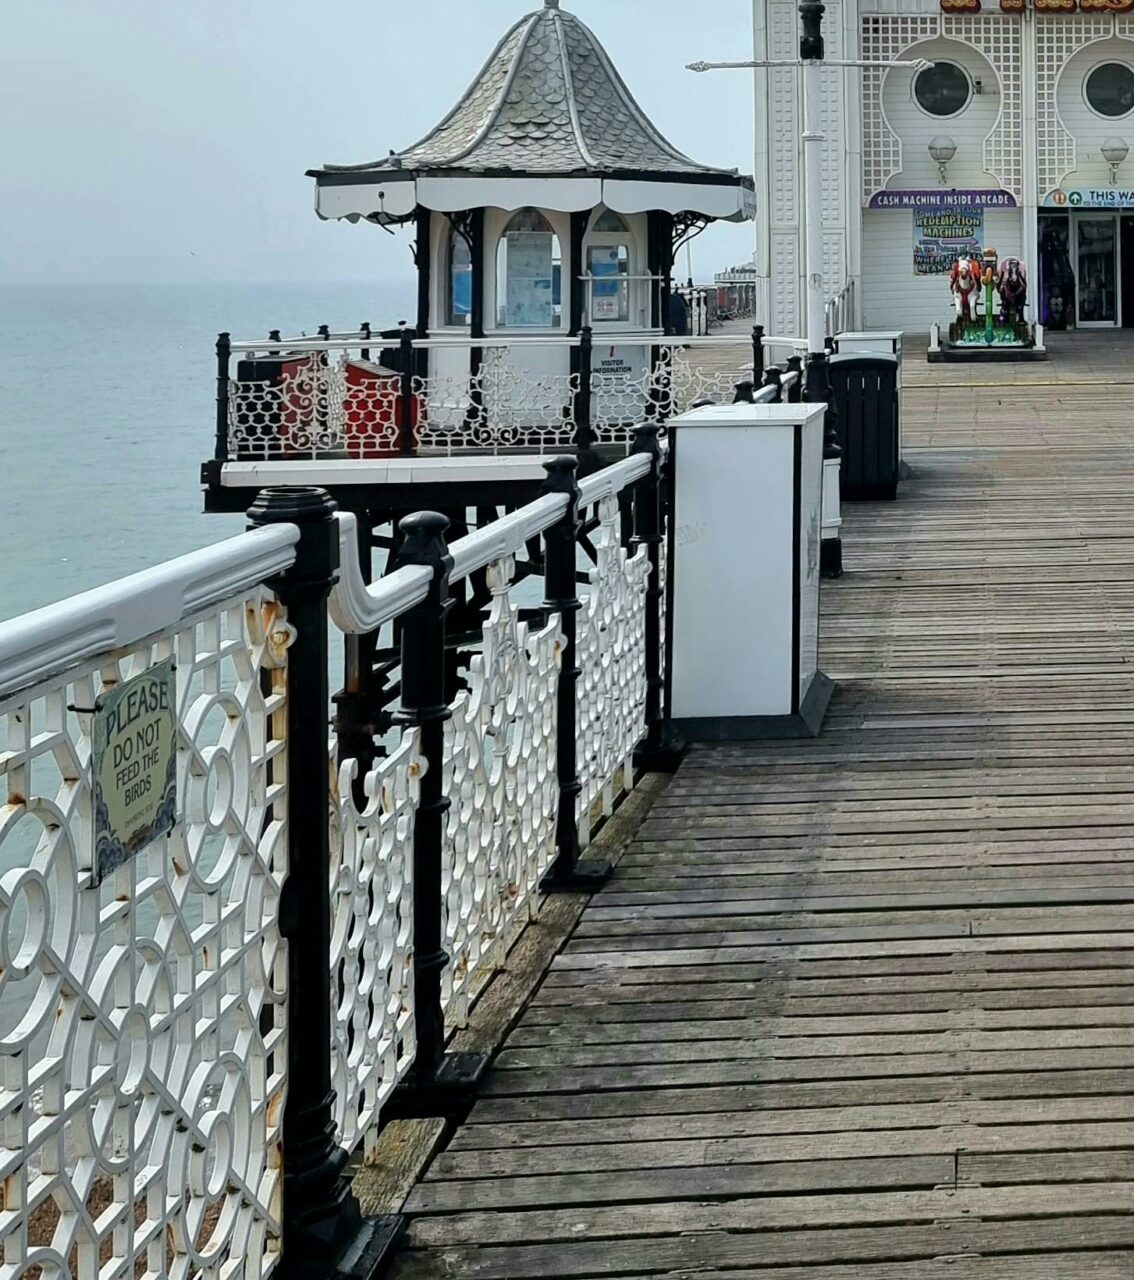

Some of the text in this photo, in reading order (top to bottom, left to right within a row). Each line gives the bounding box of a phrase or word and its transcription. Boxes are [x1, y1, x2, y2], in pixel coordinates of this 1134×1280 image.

[878, 195, 1009, 205] CASH MACHINE INSIDE ARCADE
[1090, 191, 1115, 200] THIS
[916, 216, 980, 226] REDEMPTION
[923, 227, 974, 237] MACHINES
[106, 682, 168, 747] PLEASE
[114, 718, 161, 768] DO NOT
[116, 747, 159, 790] FEED THE
[125, 774, 152, 807] BIRDS
